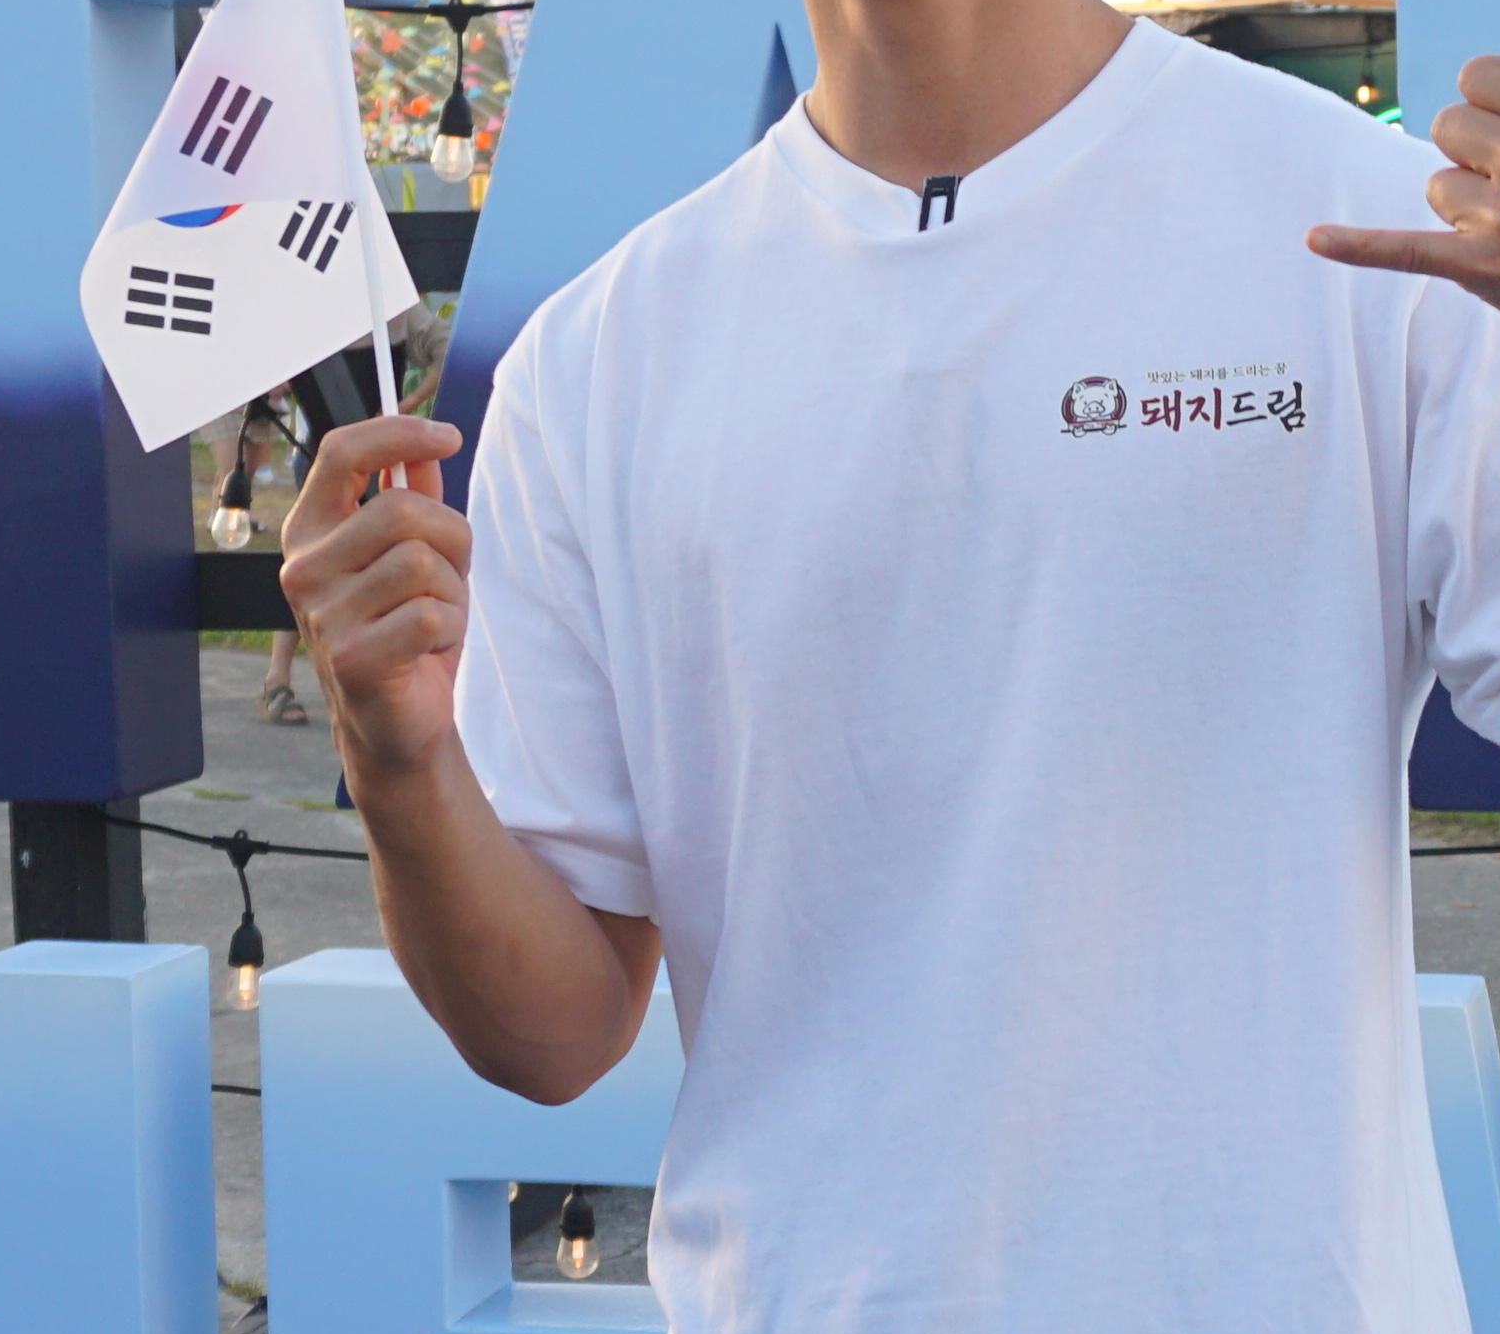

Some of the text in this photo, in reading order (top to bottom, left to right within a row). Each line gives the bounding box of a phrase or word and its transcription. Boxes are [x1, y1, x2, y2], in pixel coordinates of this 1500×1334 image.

[1147, 370, 1186, 384] 맛있는
[1190, 367, 1228, 380] 돼지를
[1233, 364, 1270, 377] 드리는
[1140, 380, 1307, 433] 돼지드림
